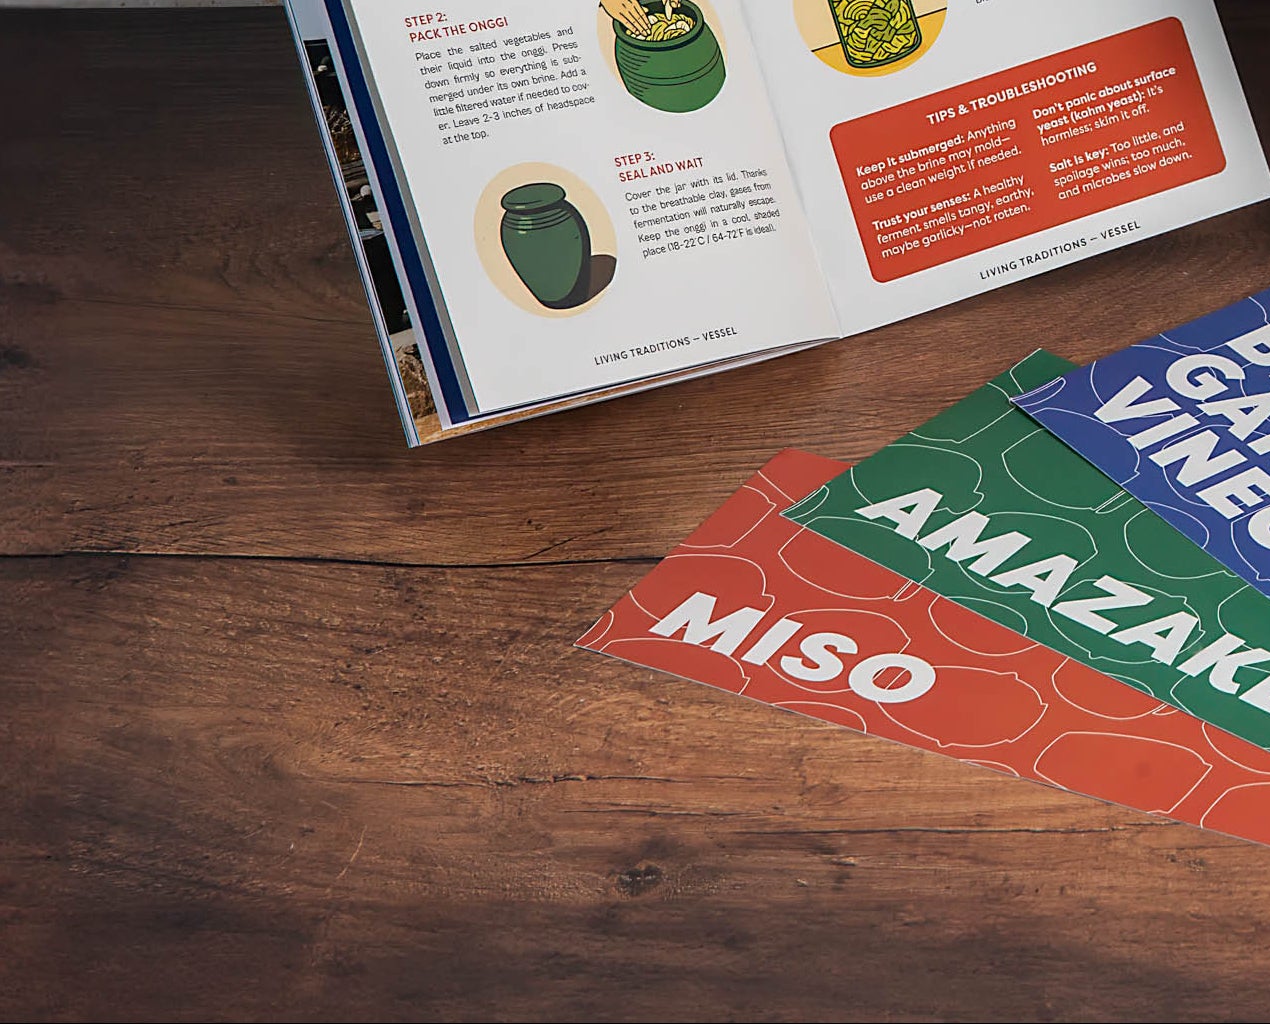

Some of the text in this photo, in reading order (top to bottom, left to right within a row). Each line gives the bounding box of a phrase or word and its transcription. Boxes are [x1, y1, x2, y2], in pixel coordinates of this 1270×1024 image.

[404, 12, 448, 28] STEP 2:
[408, 15, 509, 43] PACK THE ONGGI
[414, 25, 574, 61] Place the salted vegetables and
[925, 61, 1097, 125] TIPS & TROUBLESHOOTING
[1064, 92, 1097, 112] panic
[1098, 79, 1133, 98] about
[1133, 67, 1176, 87] surface
[1036, 115, 1069, 135] yeast
[1070, 104, 1106, 124] (kahm
[1106, 89, 1146, 113] yeast):
[1040, 103, 1150, 146] harmless; skim it off.
[613, 151, 656, 168] STEP 3:
[855, 119, 1016, 177] Keep it submerged: Anything
[860, 173, 895, 190] above
[896, 166, 916, 179] the
[917, 157, 946, 172] brine
[948, 147, 972, 162] may
[1048, 158, 1073, 173] Salt
[1073, 155, 1084, 165] is
[1084, 147, 1110, 162] key:
[1109, 140, 1131, 153] Too
[1162, 120, 1185, 136] and
[1053, 165, 1100, 188] spoilage
[1101, 155, 1130, 170] wins;
[1130, 149, 1150, 161] too
[618, 156, 703, 183] SEAL AND WAIT
[624, 190, 652, 202] Cover
[655, 186, 671, 196] the
[674, 183, 687, 195] jar
[689, 177, 710, 189] with
[712, 176, 724, 184] its
[740, 168, 768, 179] Thanks
[864, 144, 1022, 204] use a clean weight if needed.
[1058, 151, 1193, 200] and microbes slow down.
[871, 174, 1024, 231] Trust your senses: A healthy
[876, 223, 922, 244] ferment
[923, 211, 957, 230] smells
[881, 239, 920, 258] maybe
[993, 204, 1031, 222] rotten.
[979, 260, 1018, 280] LIVING
[1018, 237, 1087, 267] TRADITIONS
[1099, 220, 1141, 240] VESSEL
[593, 350, 628, 366] LIVING
[628, 336, 691, 358] TRADITIONS
[701, 326, 738, 342] VESSEL
[649, 592, 936, 704] MISO
